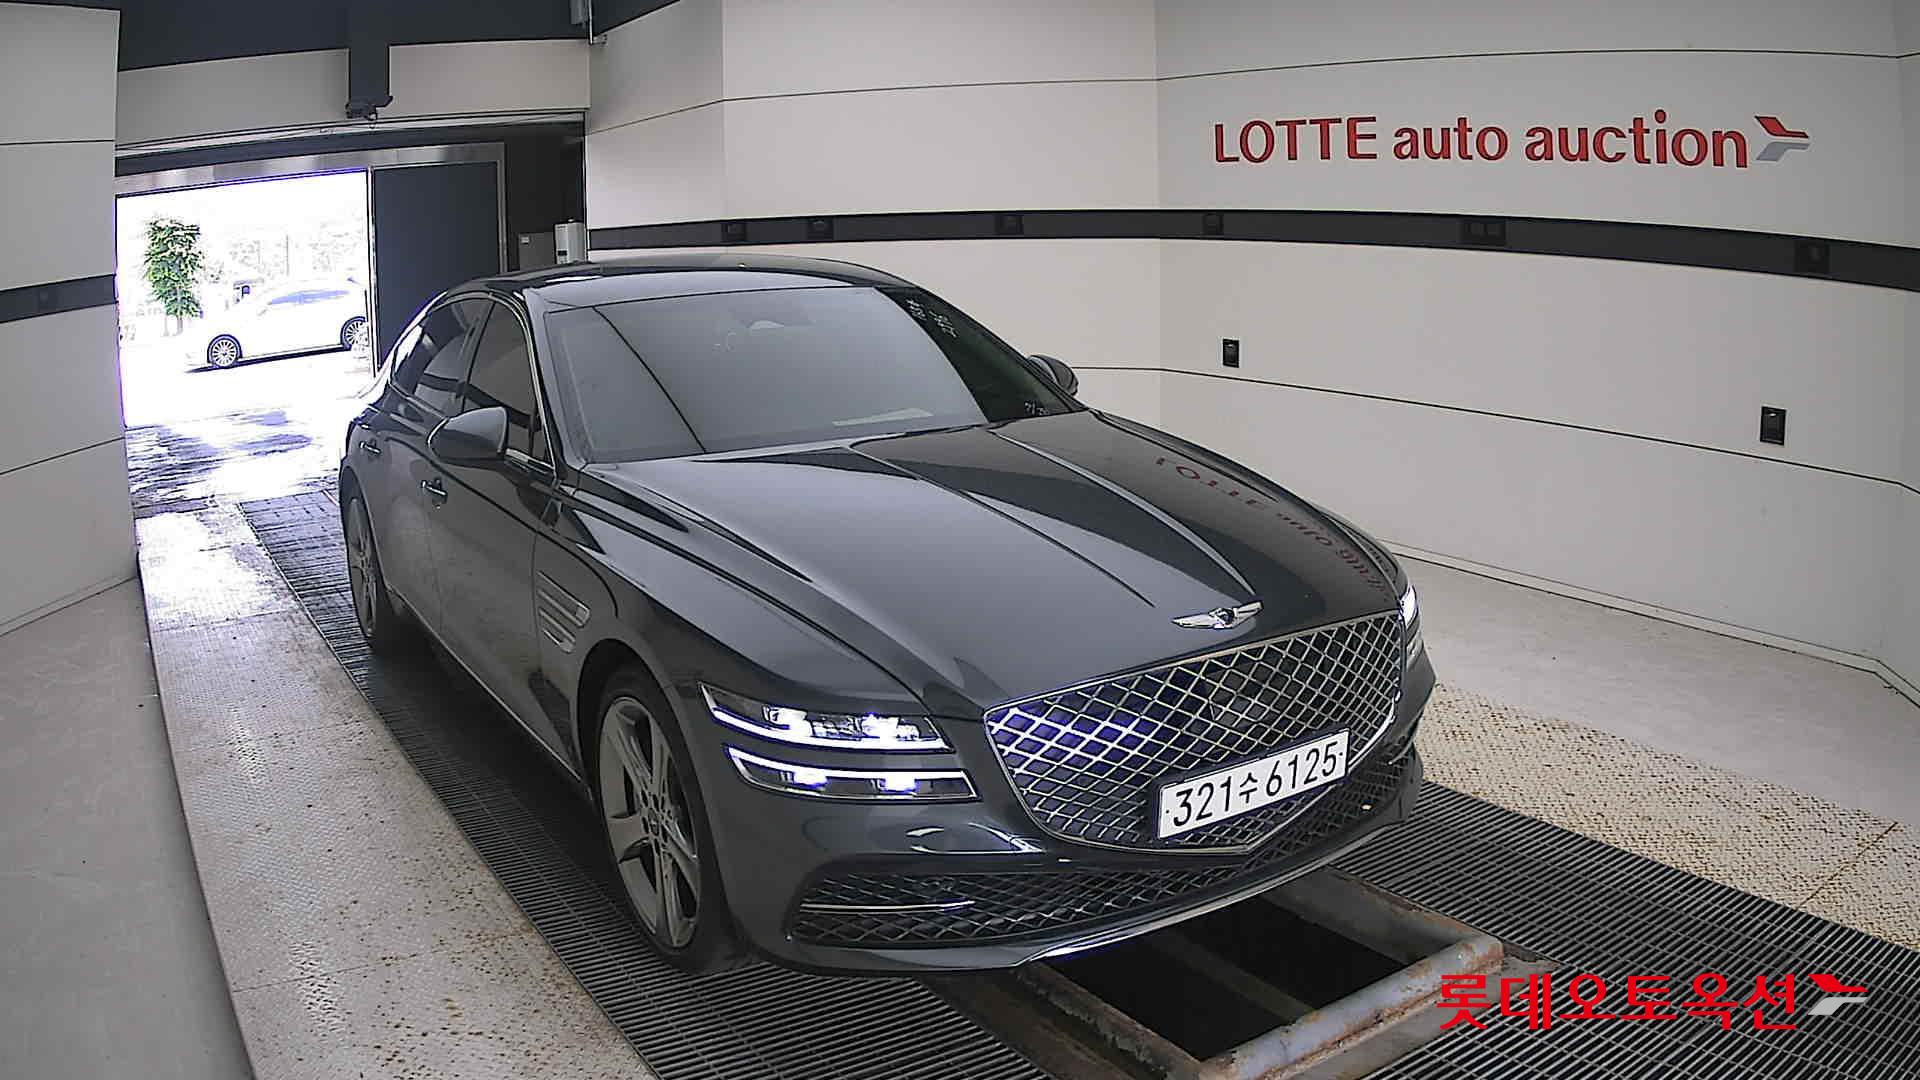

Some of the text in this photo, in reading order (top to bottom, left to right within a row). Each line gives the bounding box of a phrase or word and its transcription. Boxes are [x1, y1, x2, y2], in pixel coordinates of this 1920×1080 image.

[1214, 109, 1748, 168] LOTTE auto auction
[1173, 741, 1338, 827] 321수6125
